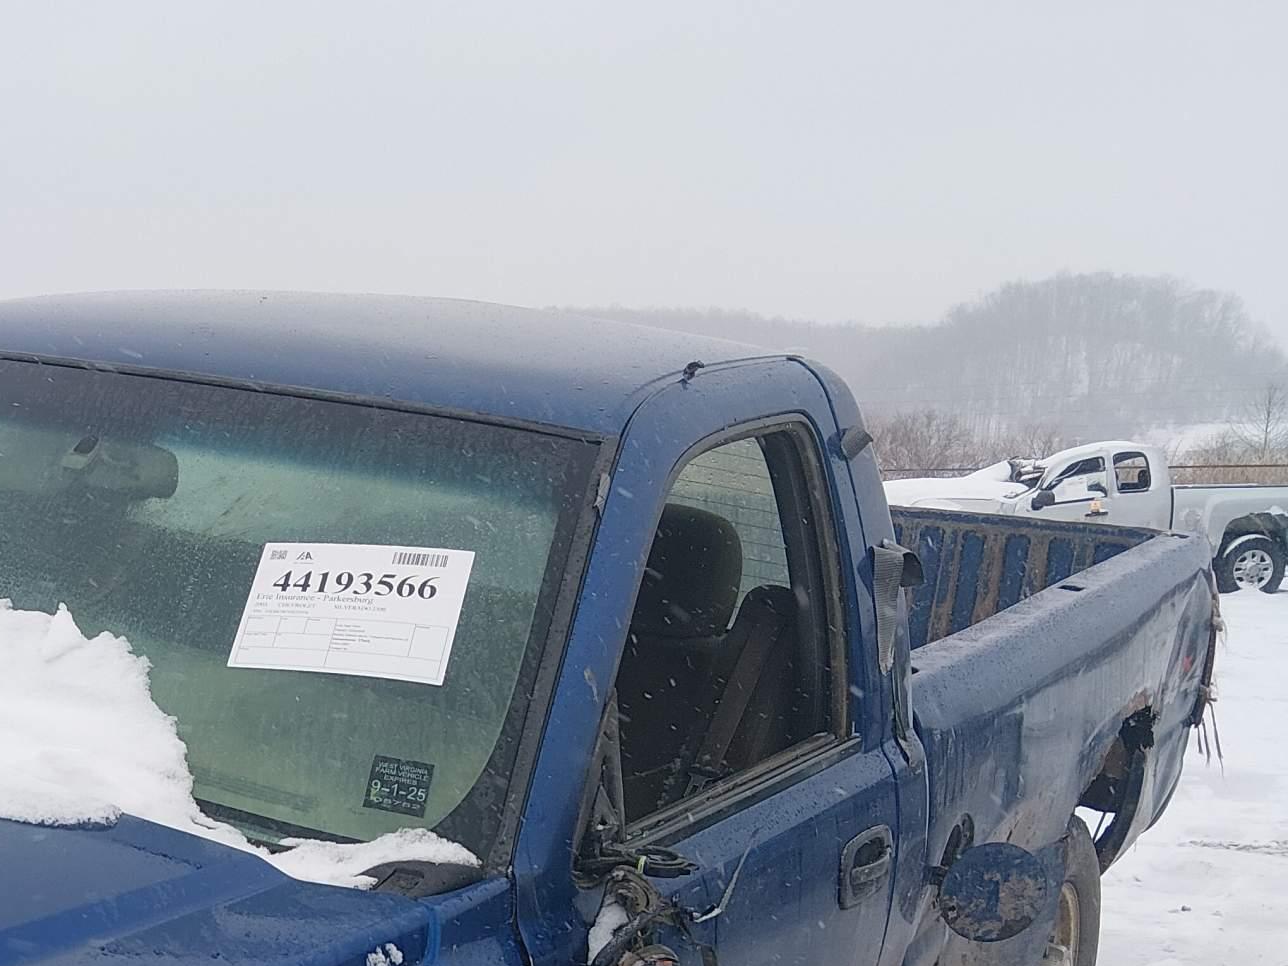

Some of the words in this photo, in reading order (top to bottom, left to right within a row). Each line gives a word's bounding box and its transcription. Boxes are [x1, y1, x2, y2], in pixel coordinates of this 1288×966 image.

[273, 570, 441, 600] 44193566
[256, 593, 274, 601] Erie
[276, 593, 316, 602] Insurance
[323, 595, 375, 605] Parkersburg
[399, 763, 428, 774] VIRGINIA
[384, 774, 417, 785] EXPIRES
[397, 770, 430, 781] VEHICLE
[371, 780, 427, 802] 9-1-25
